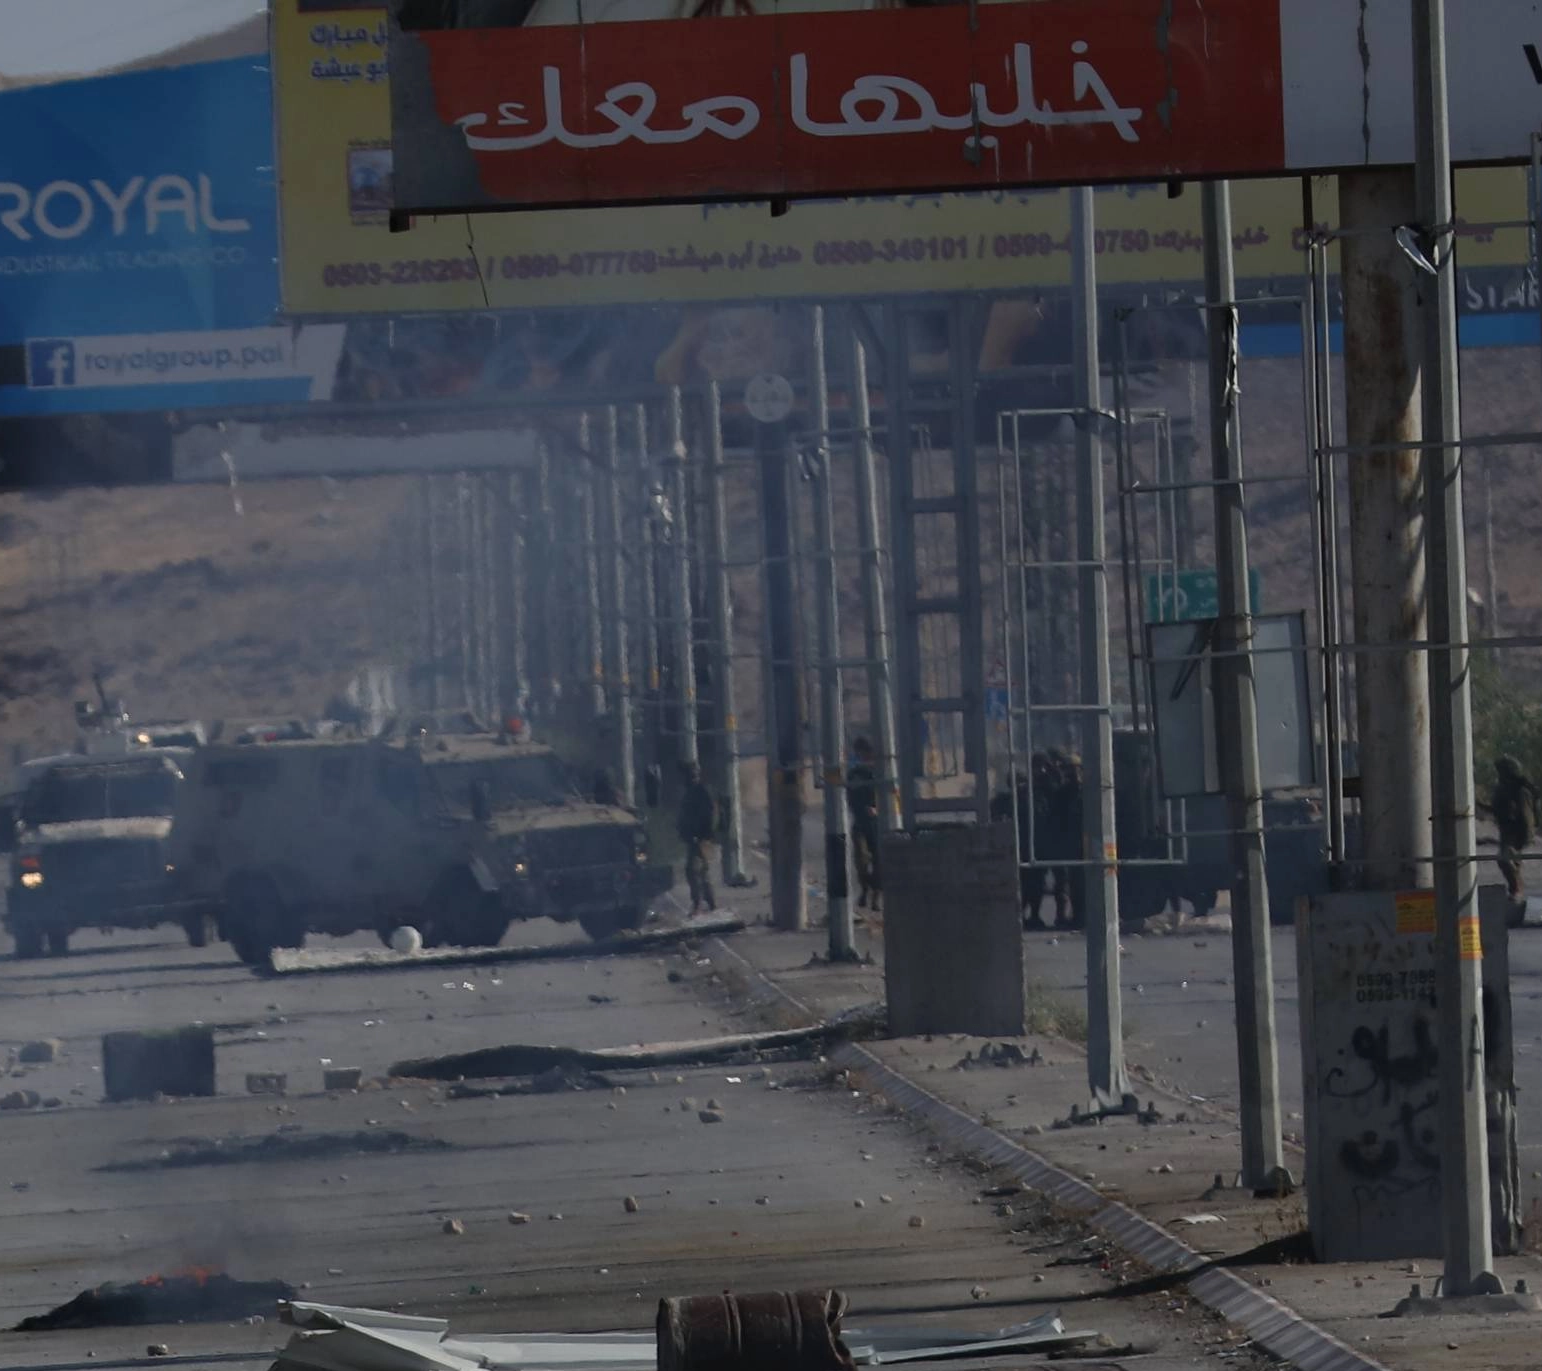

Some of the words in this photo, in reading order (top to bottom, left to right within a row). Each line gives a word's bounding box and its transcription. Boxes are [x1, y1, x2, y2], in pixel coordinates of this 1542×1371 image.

[454, 66, 760, 151] معك
[790, 41, 1141, 149] خليها
[84, 342, 285, 374] royalgroup.pal
